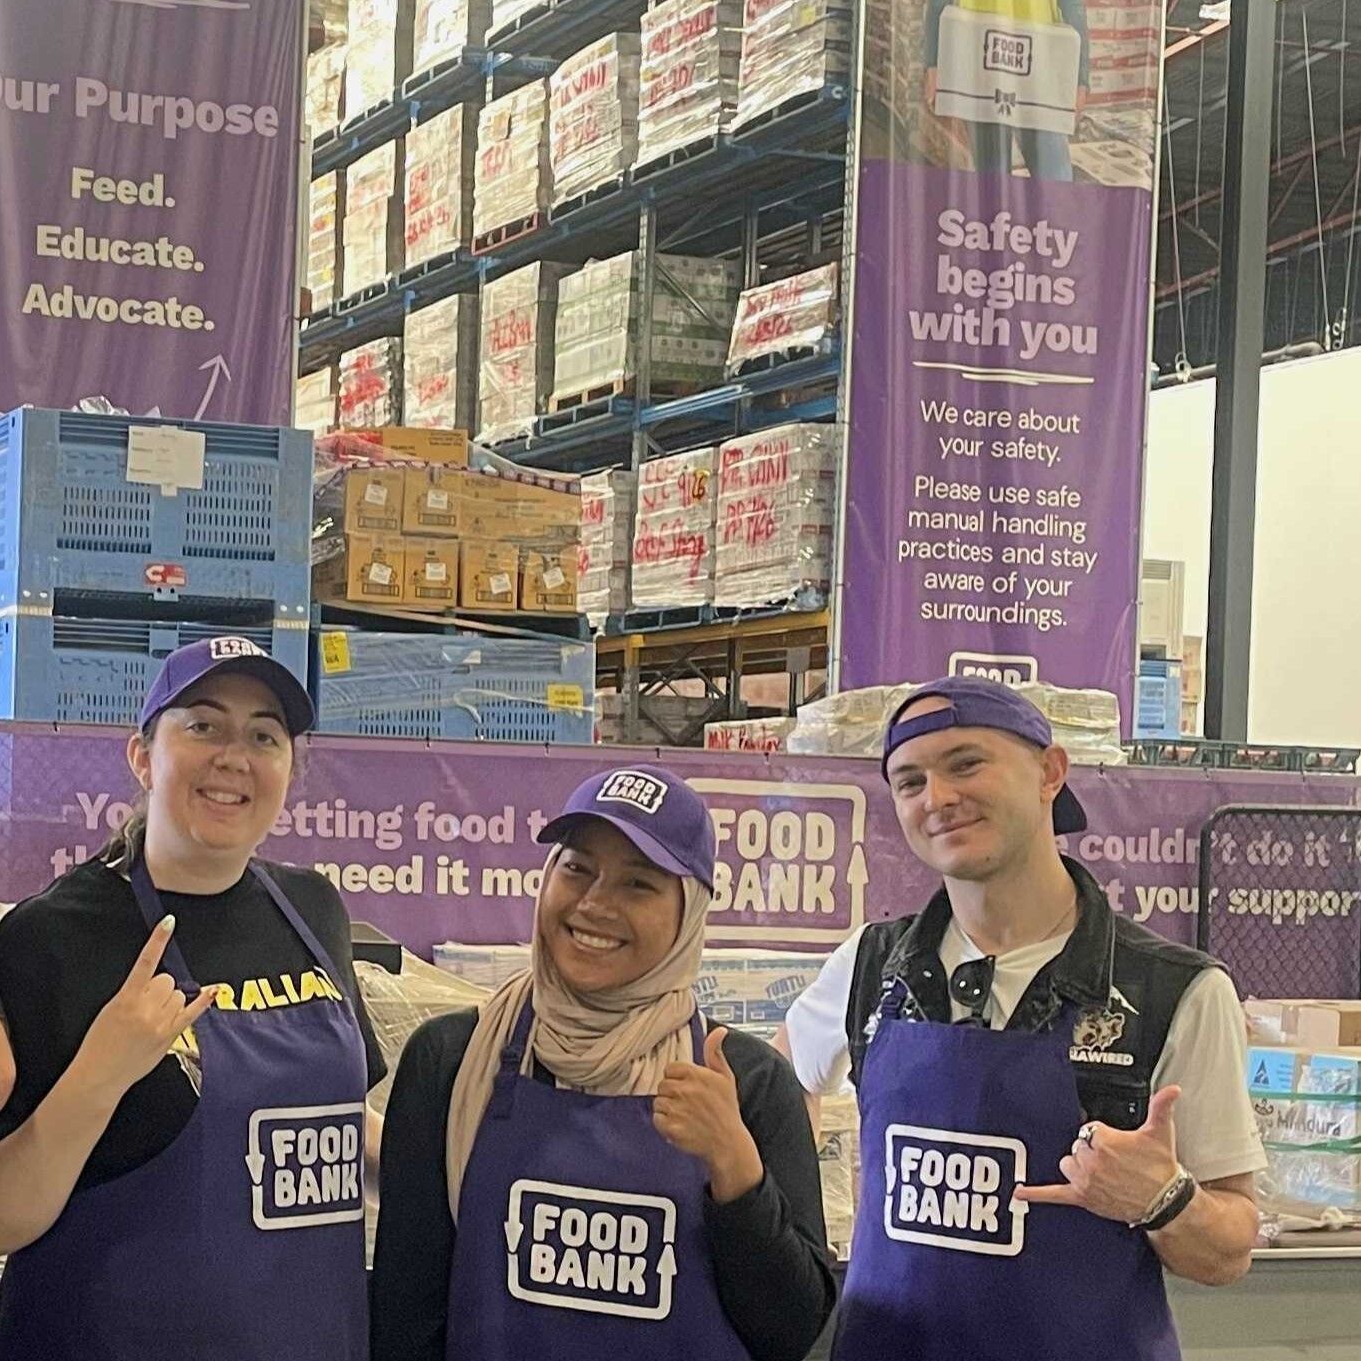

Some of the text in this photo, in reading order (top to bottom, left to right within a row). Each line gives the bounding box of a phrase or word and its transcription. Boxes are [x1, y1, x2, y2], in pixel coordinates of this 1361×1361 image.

[991, 50, 1024, 69] BANK
[992, 36, 1025, 55] FOOD
[75, 76, 279, 139] Purpose
[70, 166, 176, 209] Feed.
[36, 224, 205, 273] Educate.
[936, 209, 1079, 268] Safety
[937, 254, 1076, 309] begins
[22, 283, 215, 331] Advocate.
[909, 304, 1098, 359] with you
[920, 400, 1081, 434] We care about
[939, 437, 1061, 468] your safety.
[914, 475, 1081, 508] Please use safe
[908, 510, 1087, 544] manual handling
[898, 538, 1098, 574] practices and stay
[924, 571, 1073, 600] aware of your
[921, 601, 1067, 631] surroundings.
[607, 784, 651, 806] BANK
[614, 775, 656, 794] FOOD
[272, 799, 547, 851] etting food t
[709, 808, 835, 861] FOOD
[1247, 830, 1294, 867] do
[322, 855, 543, 898] need it mo
[711, 862, 836, 914] BANK
[1228, 886, 1361, 925] suppor
[271, 1124, 359, 1167] FOOD
[274, 1162, 359, 1208] BANK
[900, 1146, 1000, 1194] FOOD
[532, 1202, 649, 1255] FOOD
[898, 1184, 999, 1233] BANK
[529, 1243, 647, 1296] BANK
